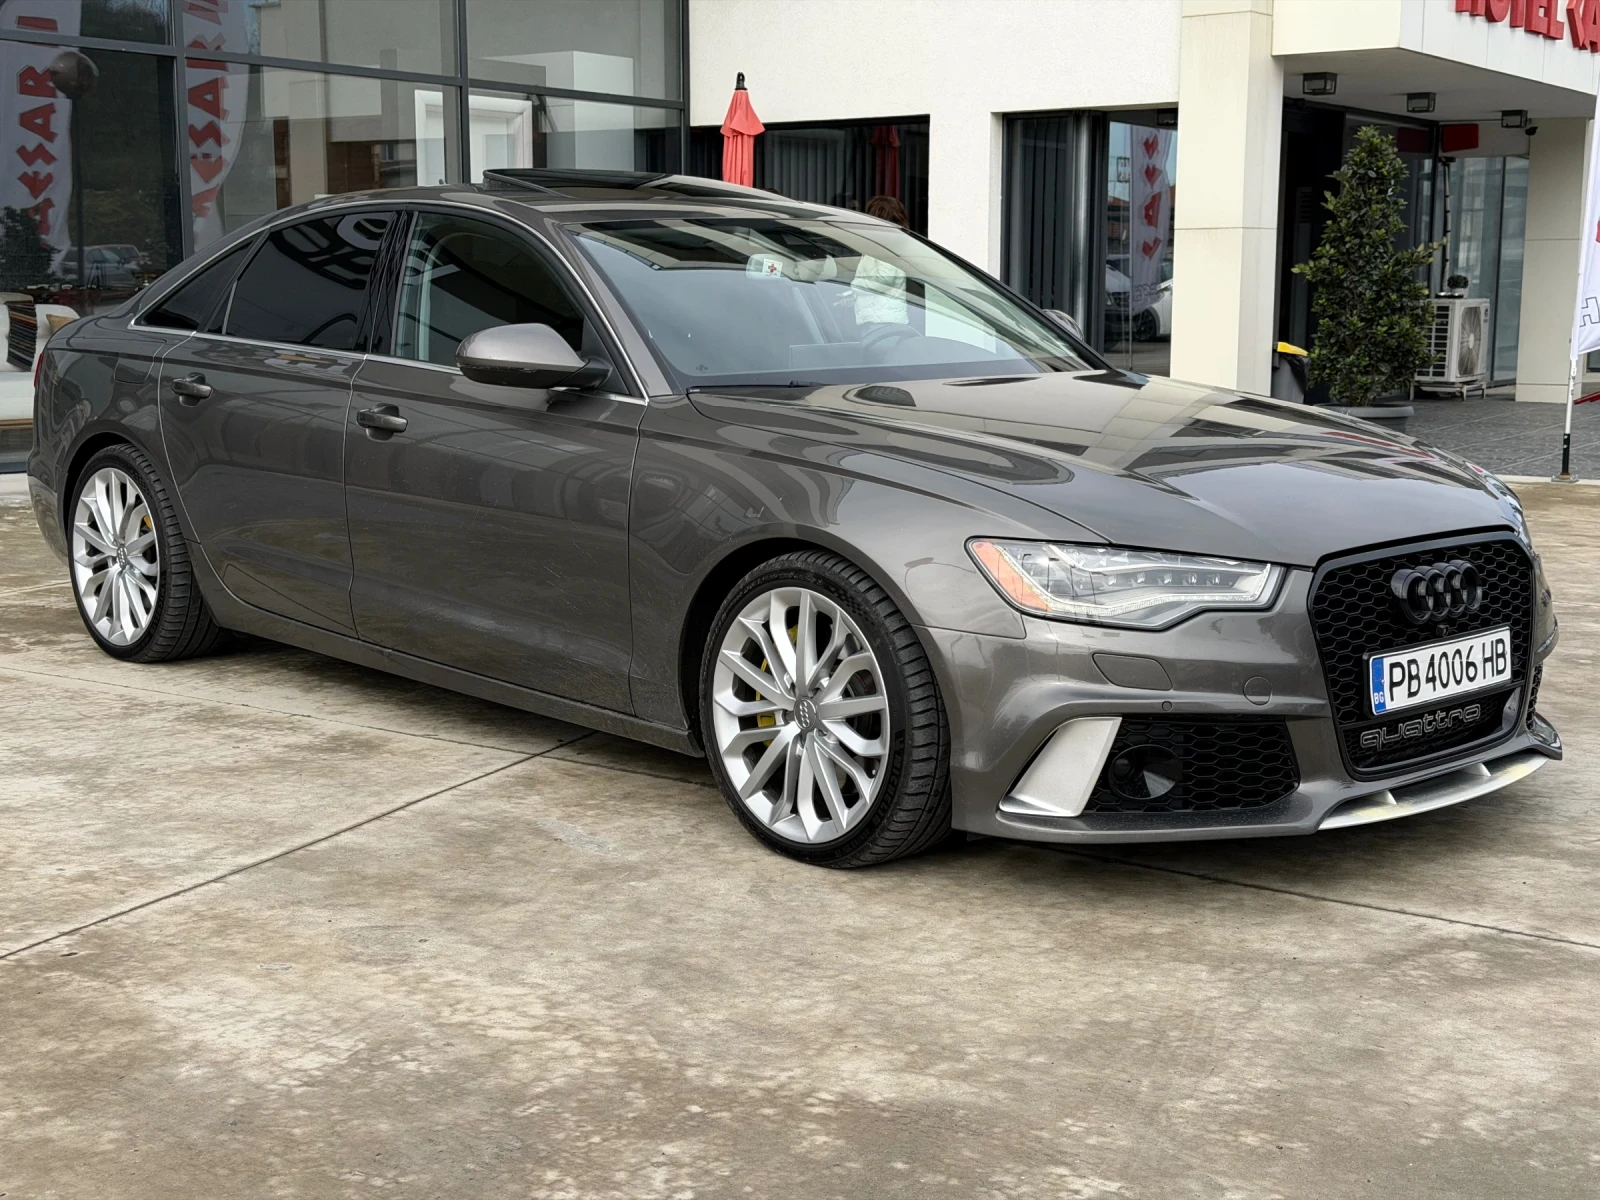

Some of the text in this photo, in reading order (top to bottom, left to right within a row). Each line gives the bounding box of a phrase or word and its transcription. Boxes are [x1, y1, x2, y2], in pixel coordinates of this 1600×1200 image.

[1455, 0, 1564, 40] TEL
[1389, 638, 1507, 702] PB 4006 HB
[1373, 692, 1385, 705] BG
[1360, 704, 1481, 750] quattro
